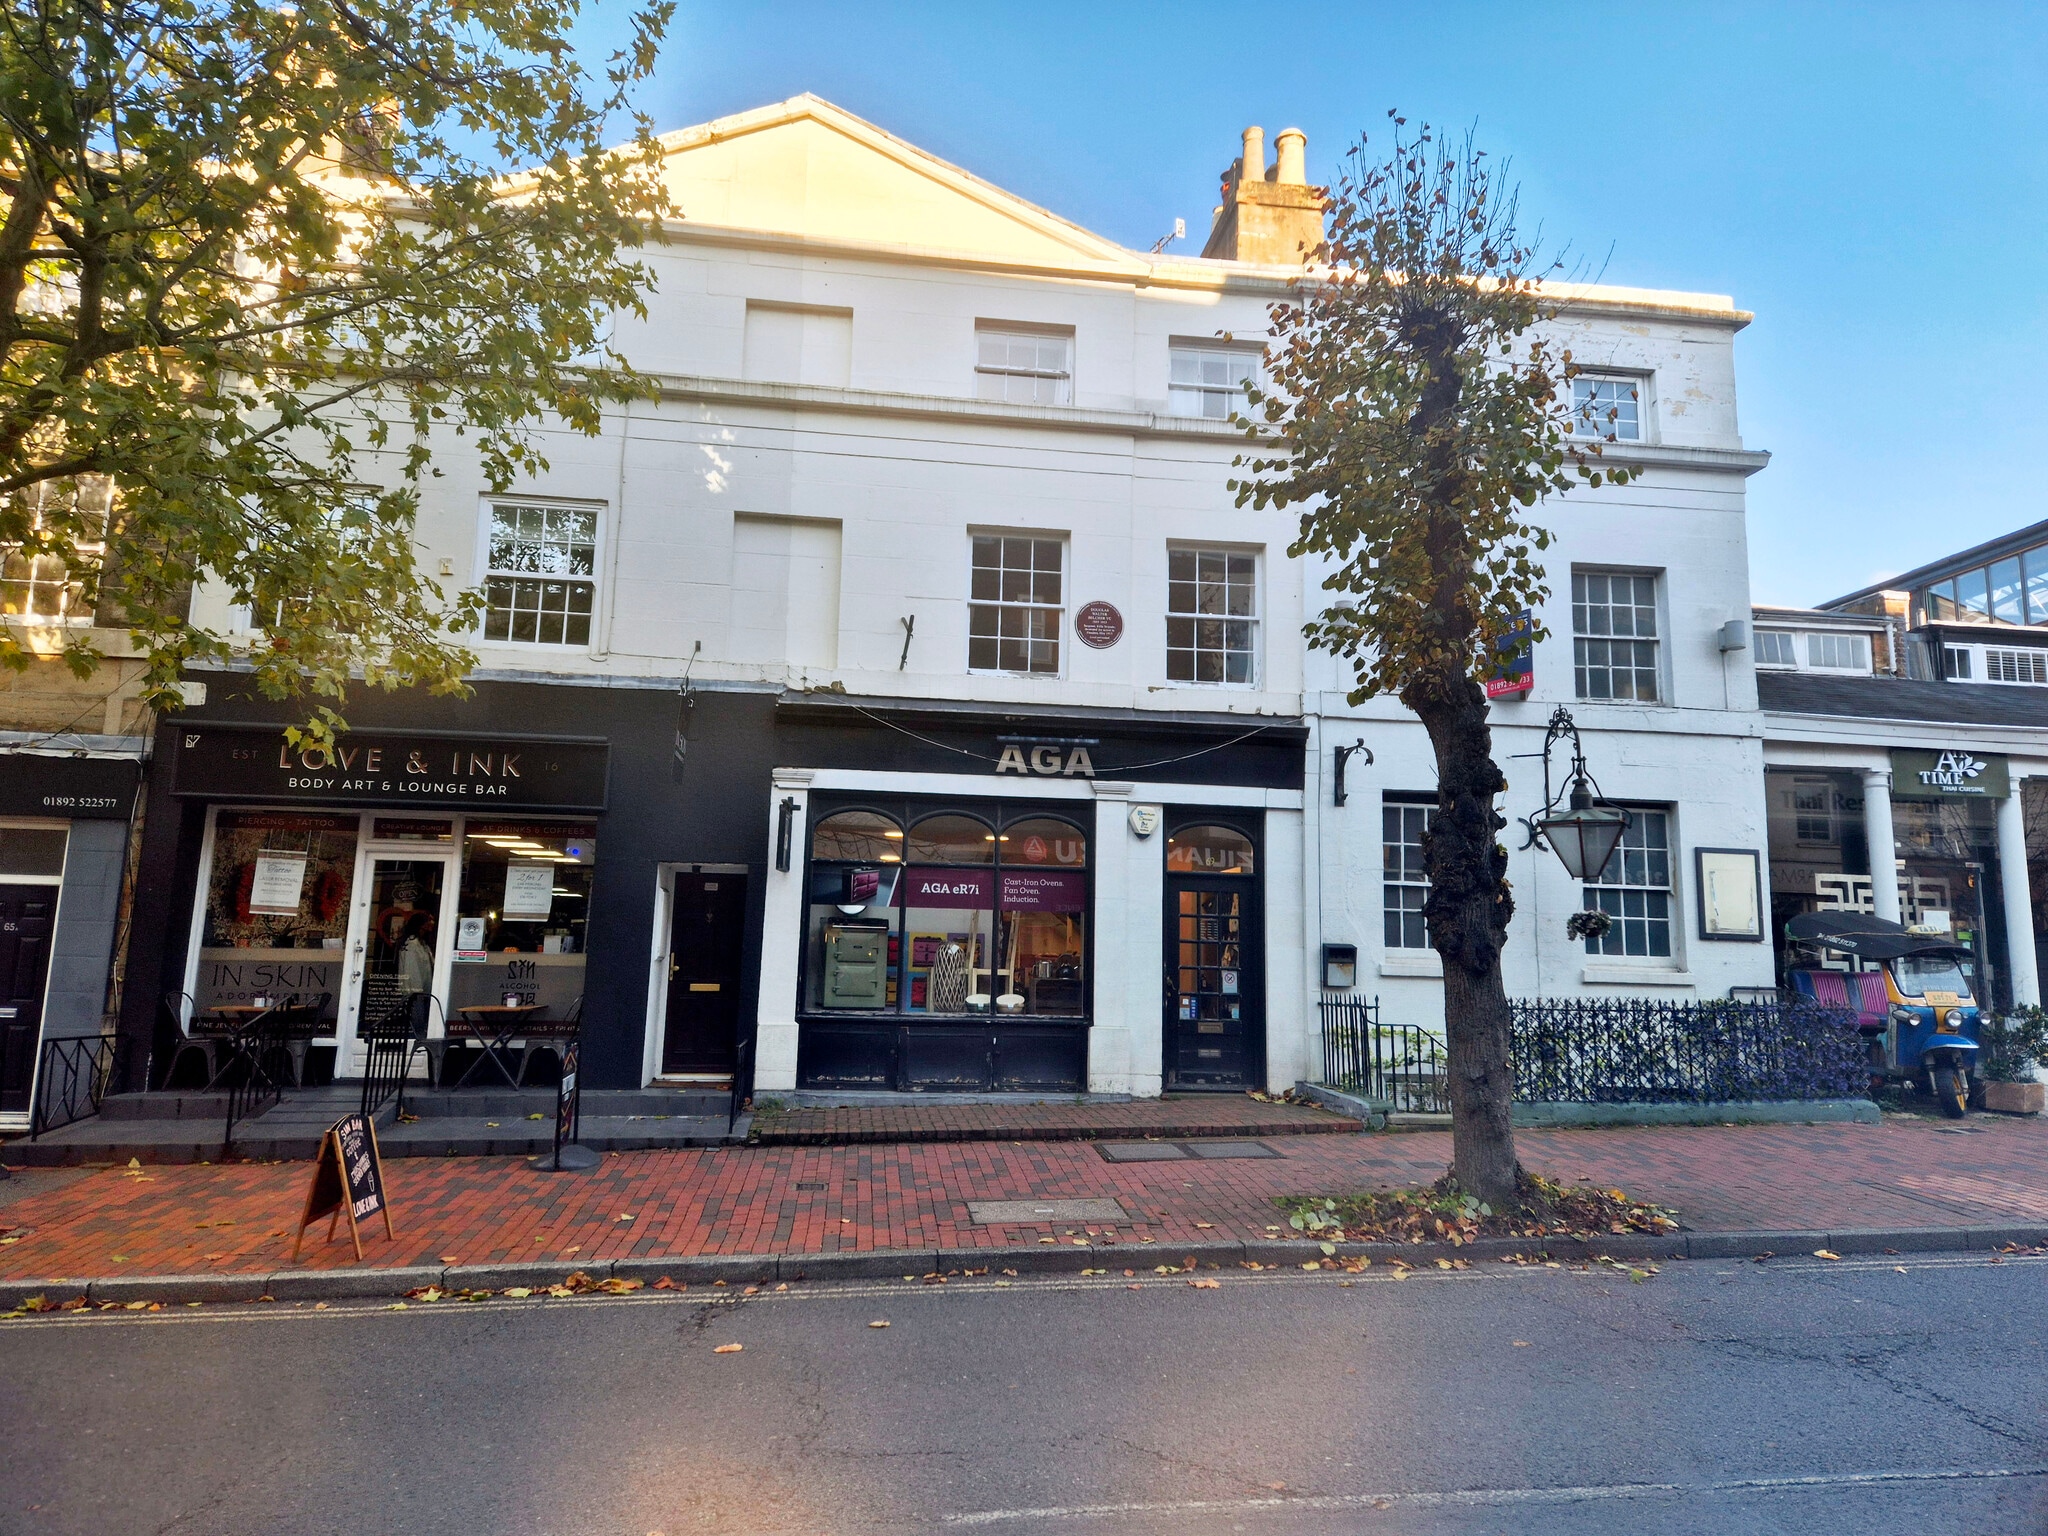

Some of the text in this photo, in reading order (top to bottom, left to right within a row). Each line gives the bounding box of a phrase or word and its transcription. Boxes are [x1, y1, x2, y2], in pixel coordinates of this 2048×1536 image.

[1490, 680, 1507, 691] 01892
[232, 749, 258, 760] EST
[279, 744, 521, 777] LOVE & INK
[995, 744, 1096, 777] AGA
[544, 761, 559, 772] 16
[1919, 771, 1965, 785] TIME
[289, 777, 508, 795] BODY ART & LOUNGE BAR
[43, 796, 117, 808] 01892 522577
[238, 816, 336, 827] PIERCING TATTOO
[497, 825, 532, 834] DRINKS
[543, 827, 585, 835] COFFEES
[1004, 878, 1065, 887] Cast-Iron Ovens.
[921, 882, 980, 895] AGA eR7i
[1004, 886, 1041, 895] Fan Oven.
[1004, 895, 1040, 903] Induction.
[212, 964, 327, 988] IN SKIN
[499, 982, 541, 990] ALCOHOL
